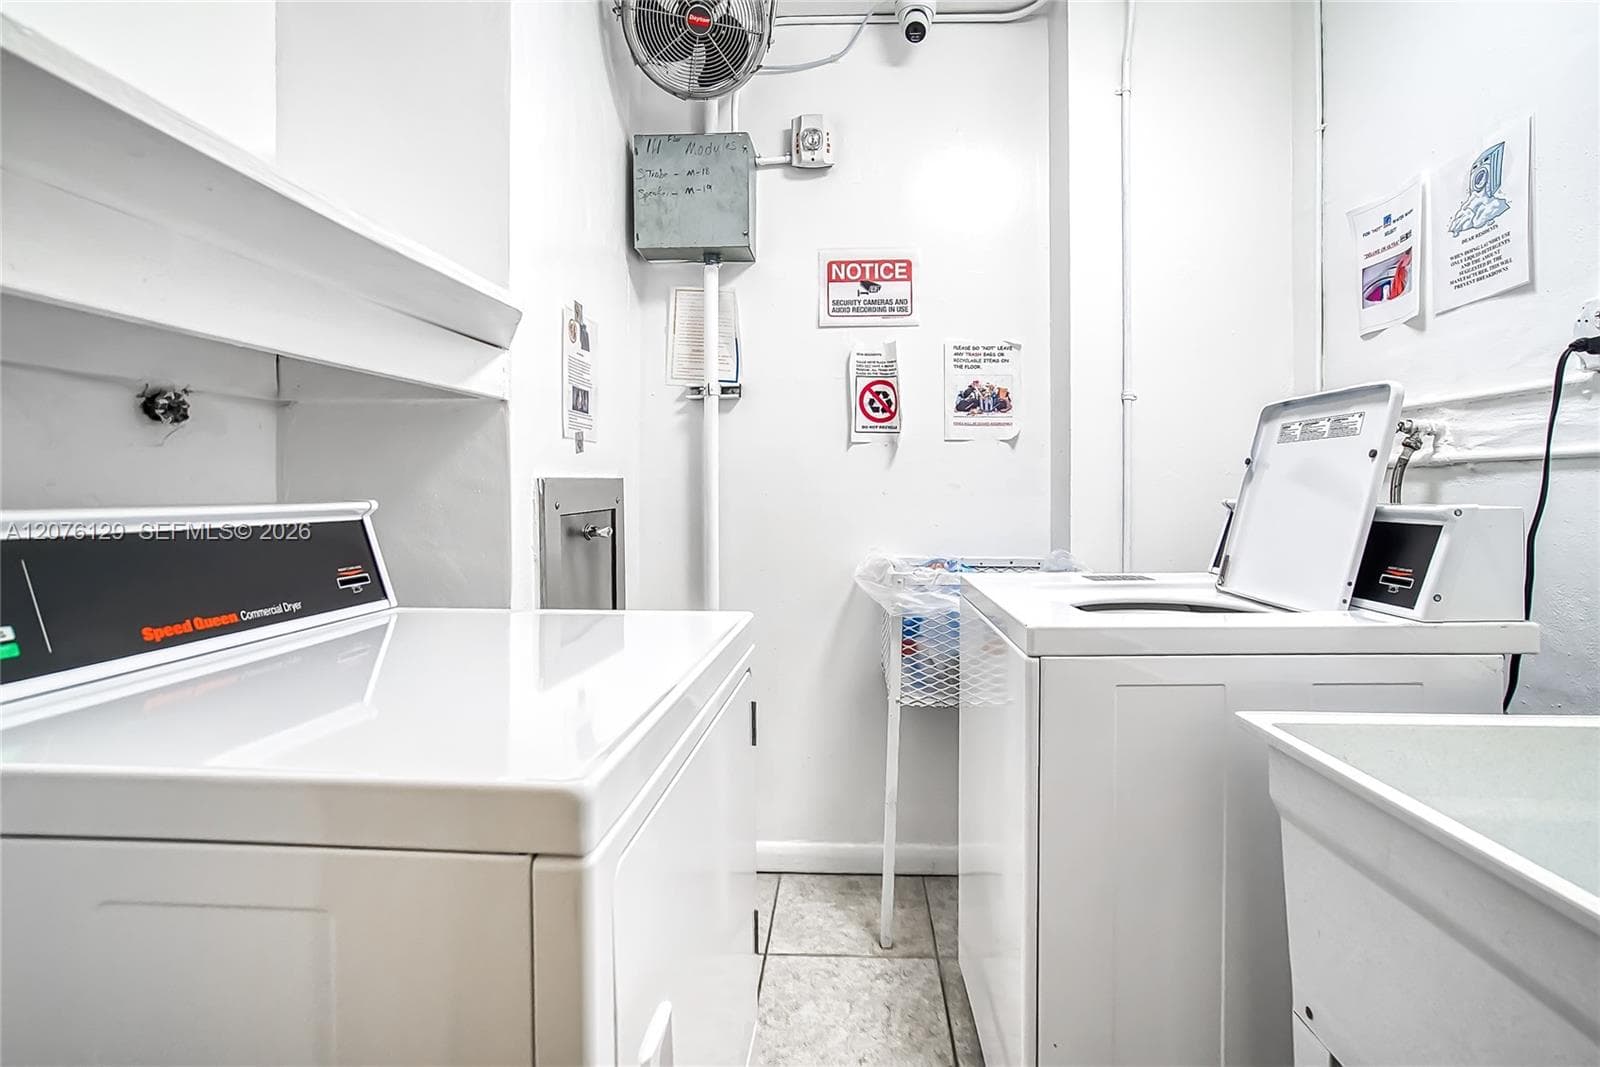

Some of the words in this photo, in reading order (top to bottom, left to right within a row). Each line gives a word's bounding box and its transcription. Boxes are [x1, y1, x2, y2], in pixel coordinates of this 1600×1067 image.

[831, 262, 908, 280] NOTICE
[141, 619, 193, 642] Speed
[193, 612, 240, 631] Queen
[240, 603, 283, 622] Commercial
[283, 600, 302, 614] Dryer
